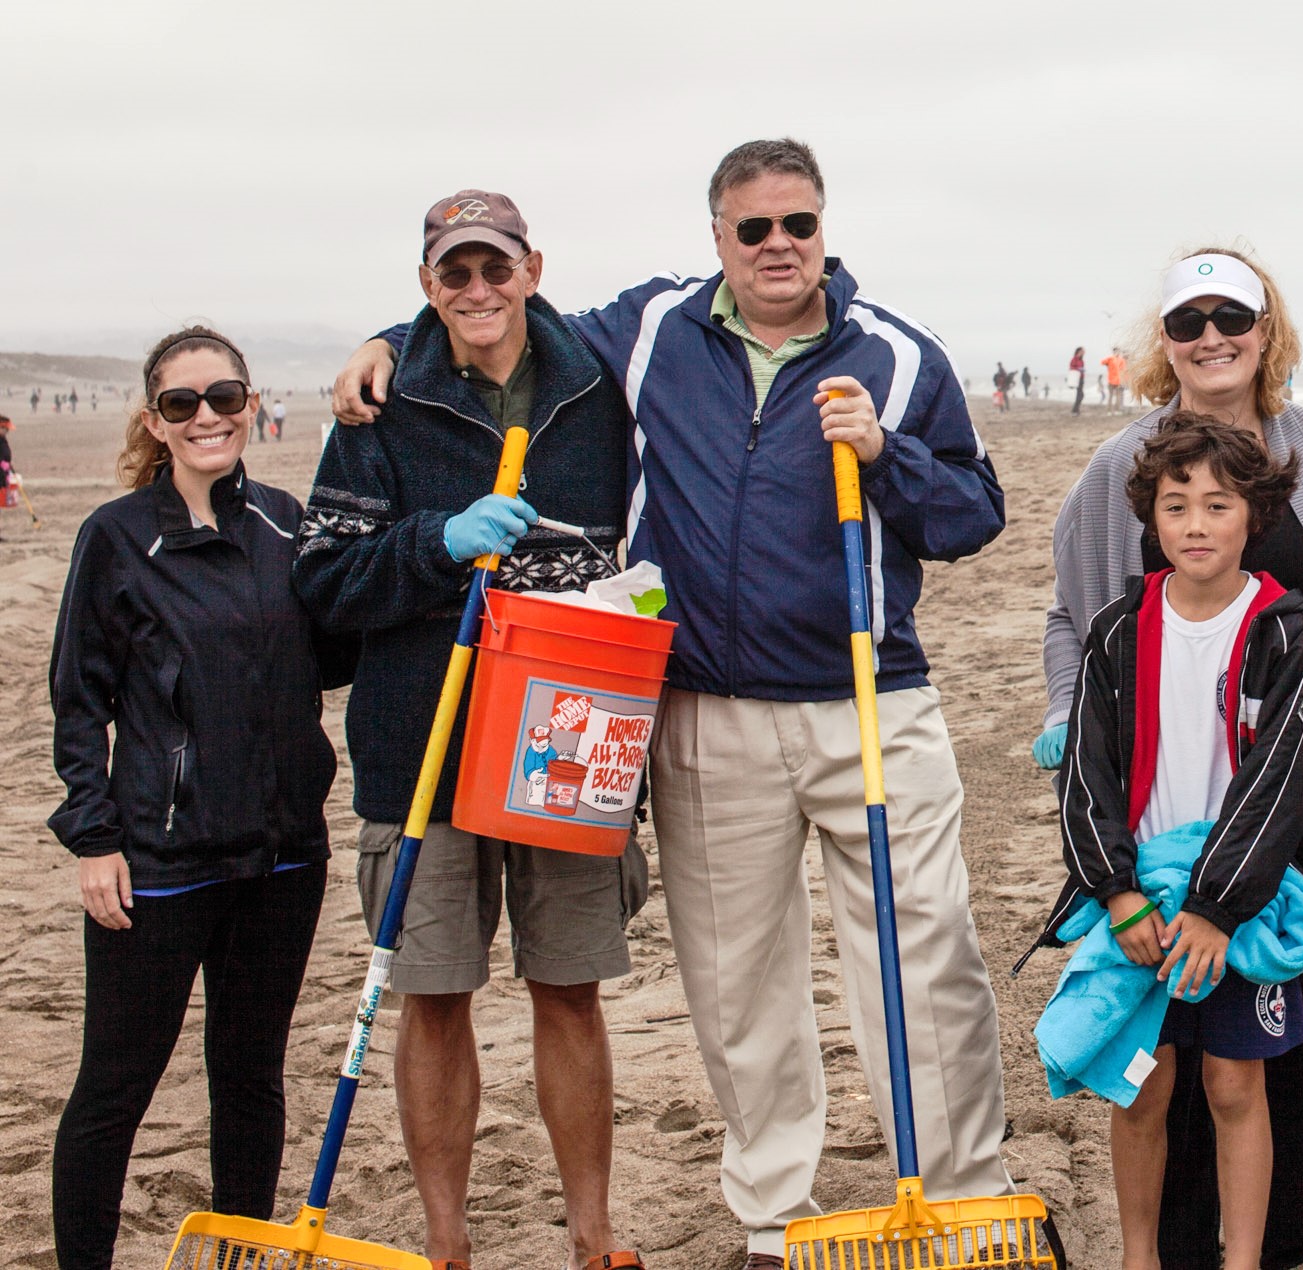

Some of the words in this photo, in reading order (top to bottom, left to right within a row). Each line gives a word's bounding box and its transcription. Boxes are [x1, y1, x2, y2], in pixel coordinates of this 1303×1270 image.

[550, 696, 592, 729] HOME
[556, 696, 575, 711] THE
[563, 710, 589, 731] DEPOT
[591, 767, 636, 793] BUCKET
[594, 794, 600, 803] 5
[600, 795, 623, 806] Gallons
